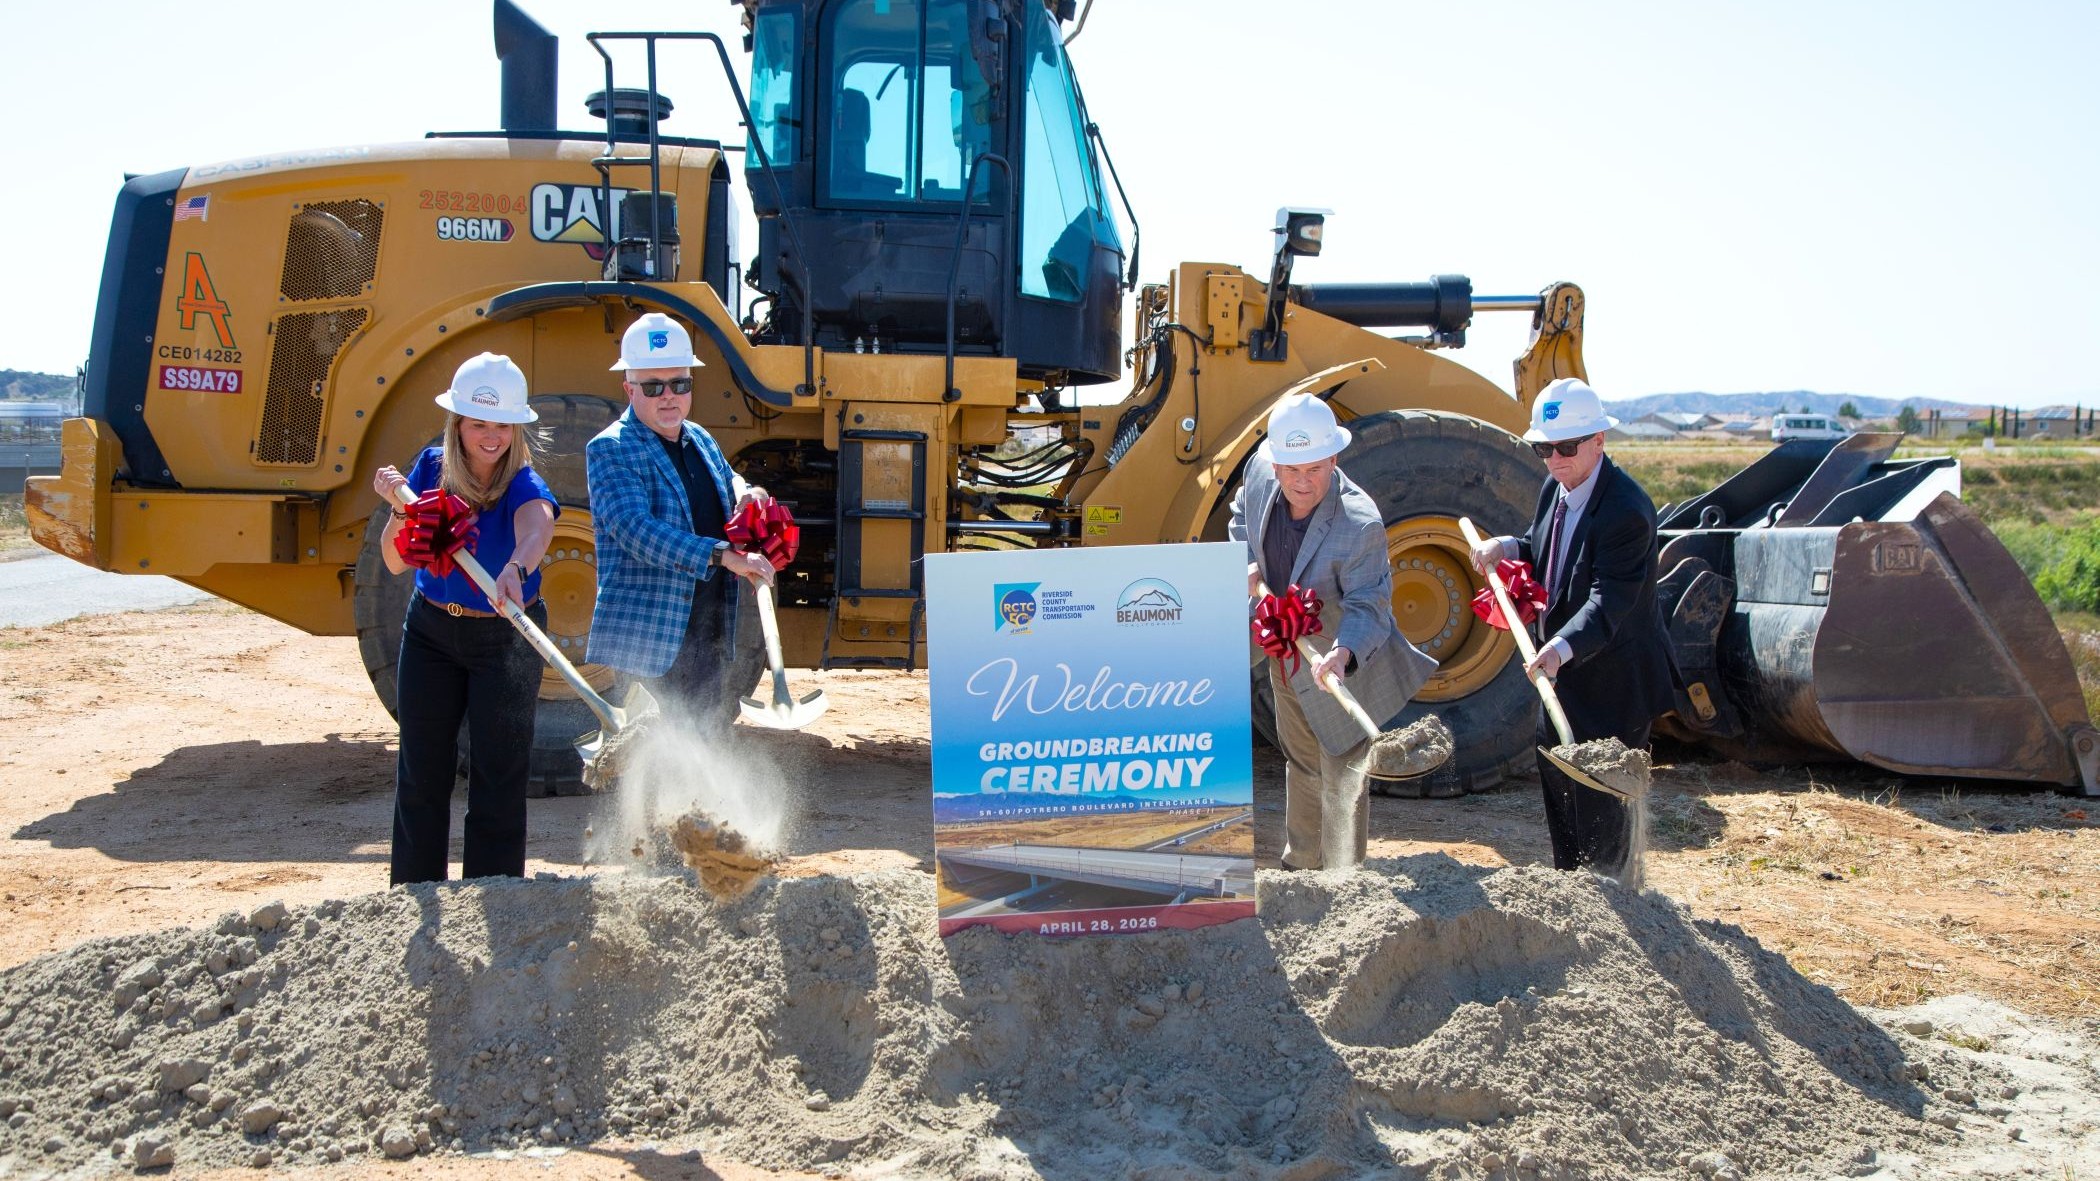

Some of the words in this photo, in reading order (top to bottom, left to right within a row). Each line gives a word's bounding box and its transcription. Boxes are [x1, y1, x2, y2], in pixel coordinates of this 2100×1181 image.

[419, 189, 528, 214] 2522004
[532, 184, 629, 244] CAT
[437, 217, 501, 241] 966M
[176, 251, 237, 349] A
[158, 345, 242, 364] CE014282
[164, 367, 238, 391] SS9A79
[471, 396, 499, 407] BEAUMONT
[1885, 547, 1916, 568] CAT
[1004, 602, 1034, 612] RCTC
[1042, 605, 1095, 613] TRANSPORTATION
[1042, 612, 1082, 620] COMMISSION
[1117, 608, 1183, 623] BEAUMONT
[966, 657, 1216, 722] Welcome
[979, 732, 1213, 762] GROUNDBREAKING
[980, 756, 1216, 795] CEREMONY
[979, 805, 1066, 817] SR-60/POTRERO
[1072, 802, 1134, 812] BOULEVARD
[1140, 798, 1215, 808] INTERCHANGE
[1169, 808, 1201, 816] PHASE
[1040, 921, 1086, 934] APRIL
[1091, 920, 1114, 931] 28,
[1120, 917, 1157, 929] 2026
